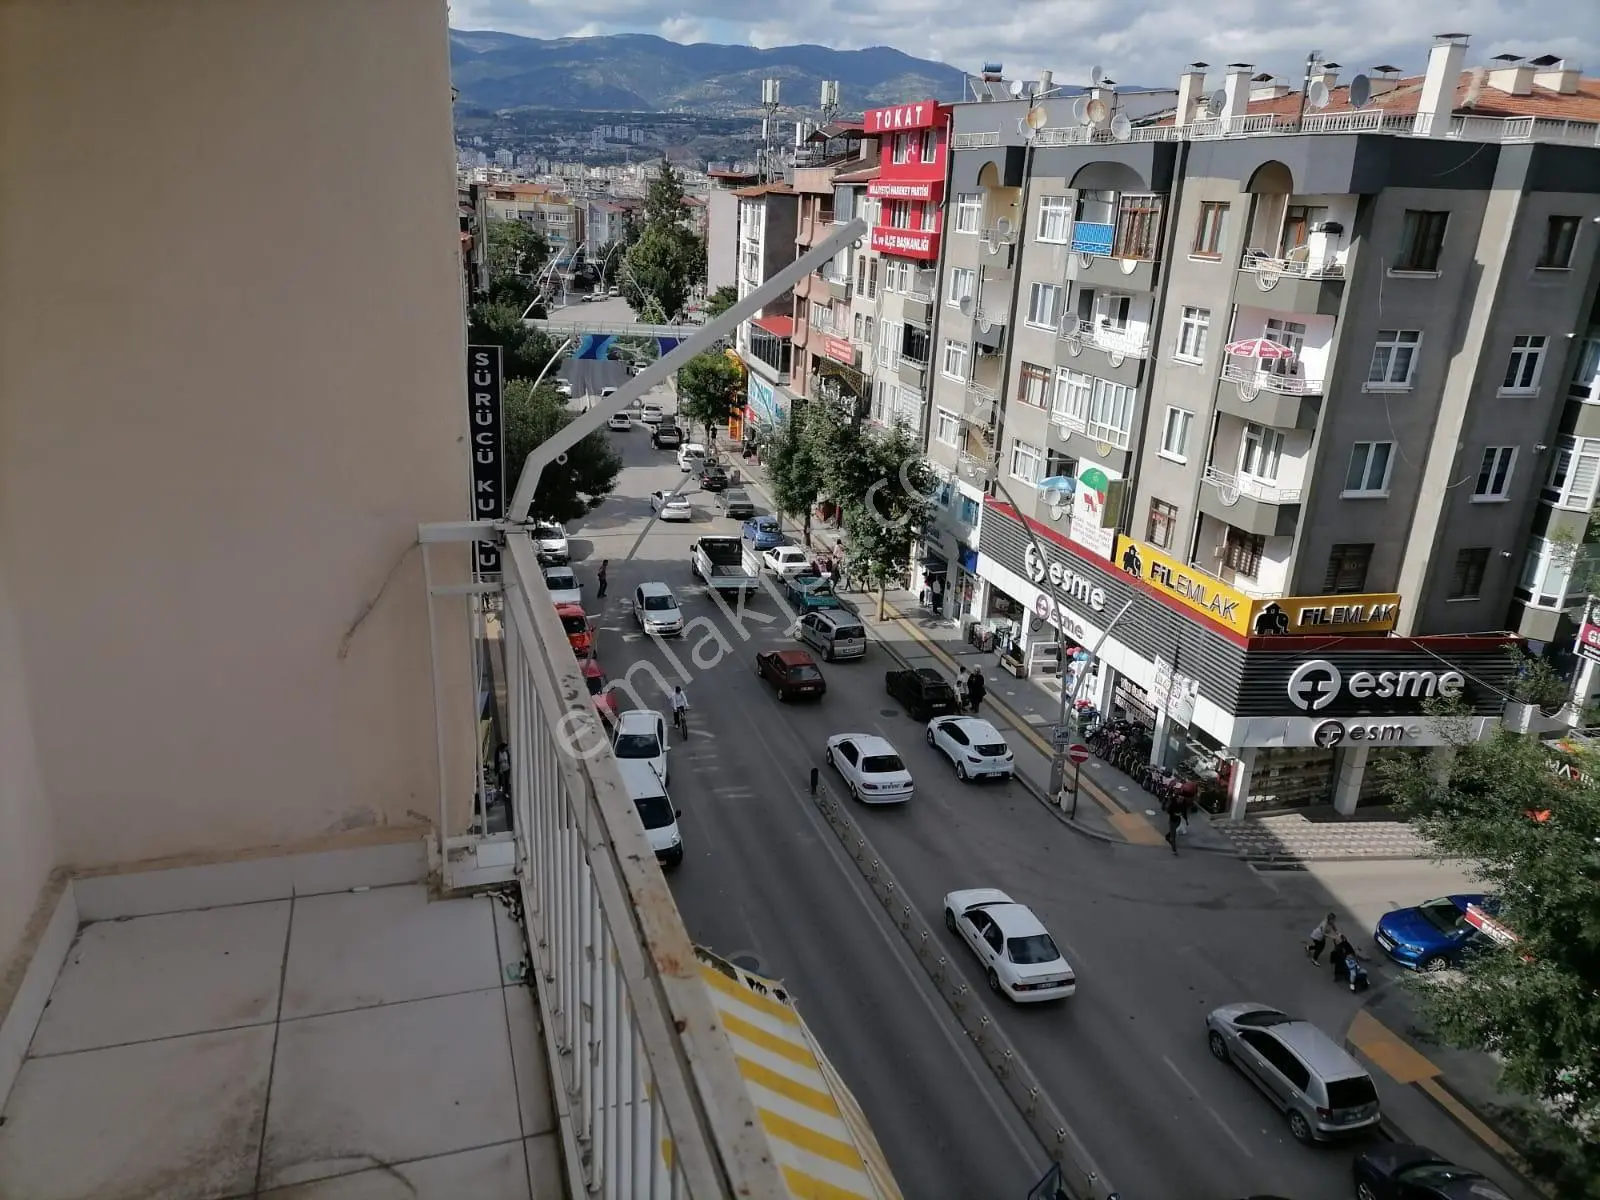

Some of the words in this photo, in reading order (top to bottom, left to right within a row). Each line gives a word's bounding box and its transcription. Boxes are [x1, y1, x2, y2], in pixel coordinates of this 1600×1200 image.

[876, 105, 923, 130] TOKAT
[474, 352, 494, 465] SÜRÜCÜ
[478, 480, 497, 567] KUSU
[1049, 560, 1107, 612] esme
[1050, 608, 1086, 640] eme
[1348, 670, 1466, 699] esme
[1348, 722, 1423, 741] esme
